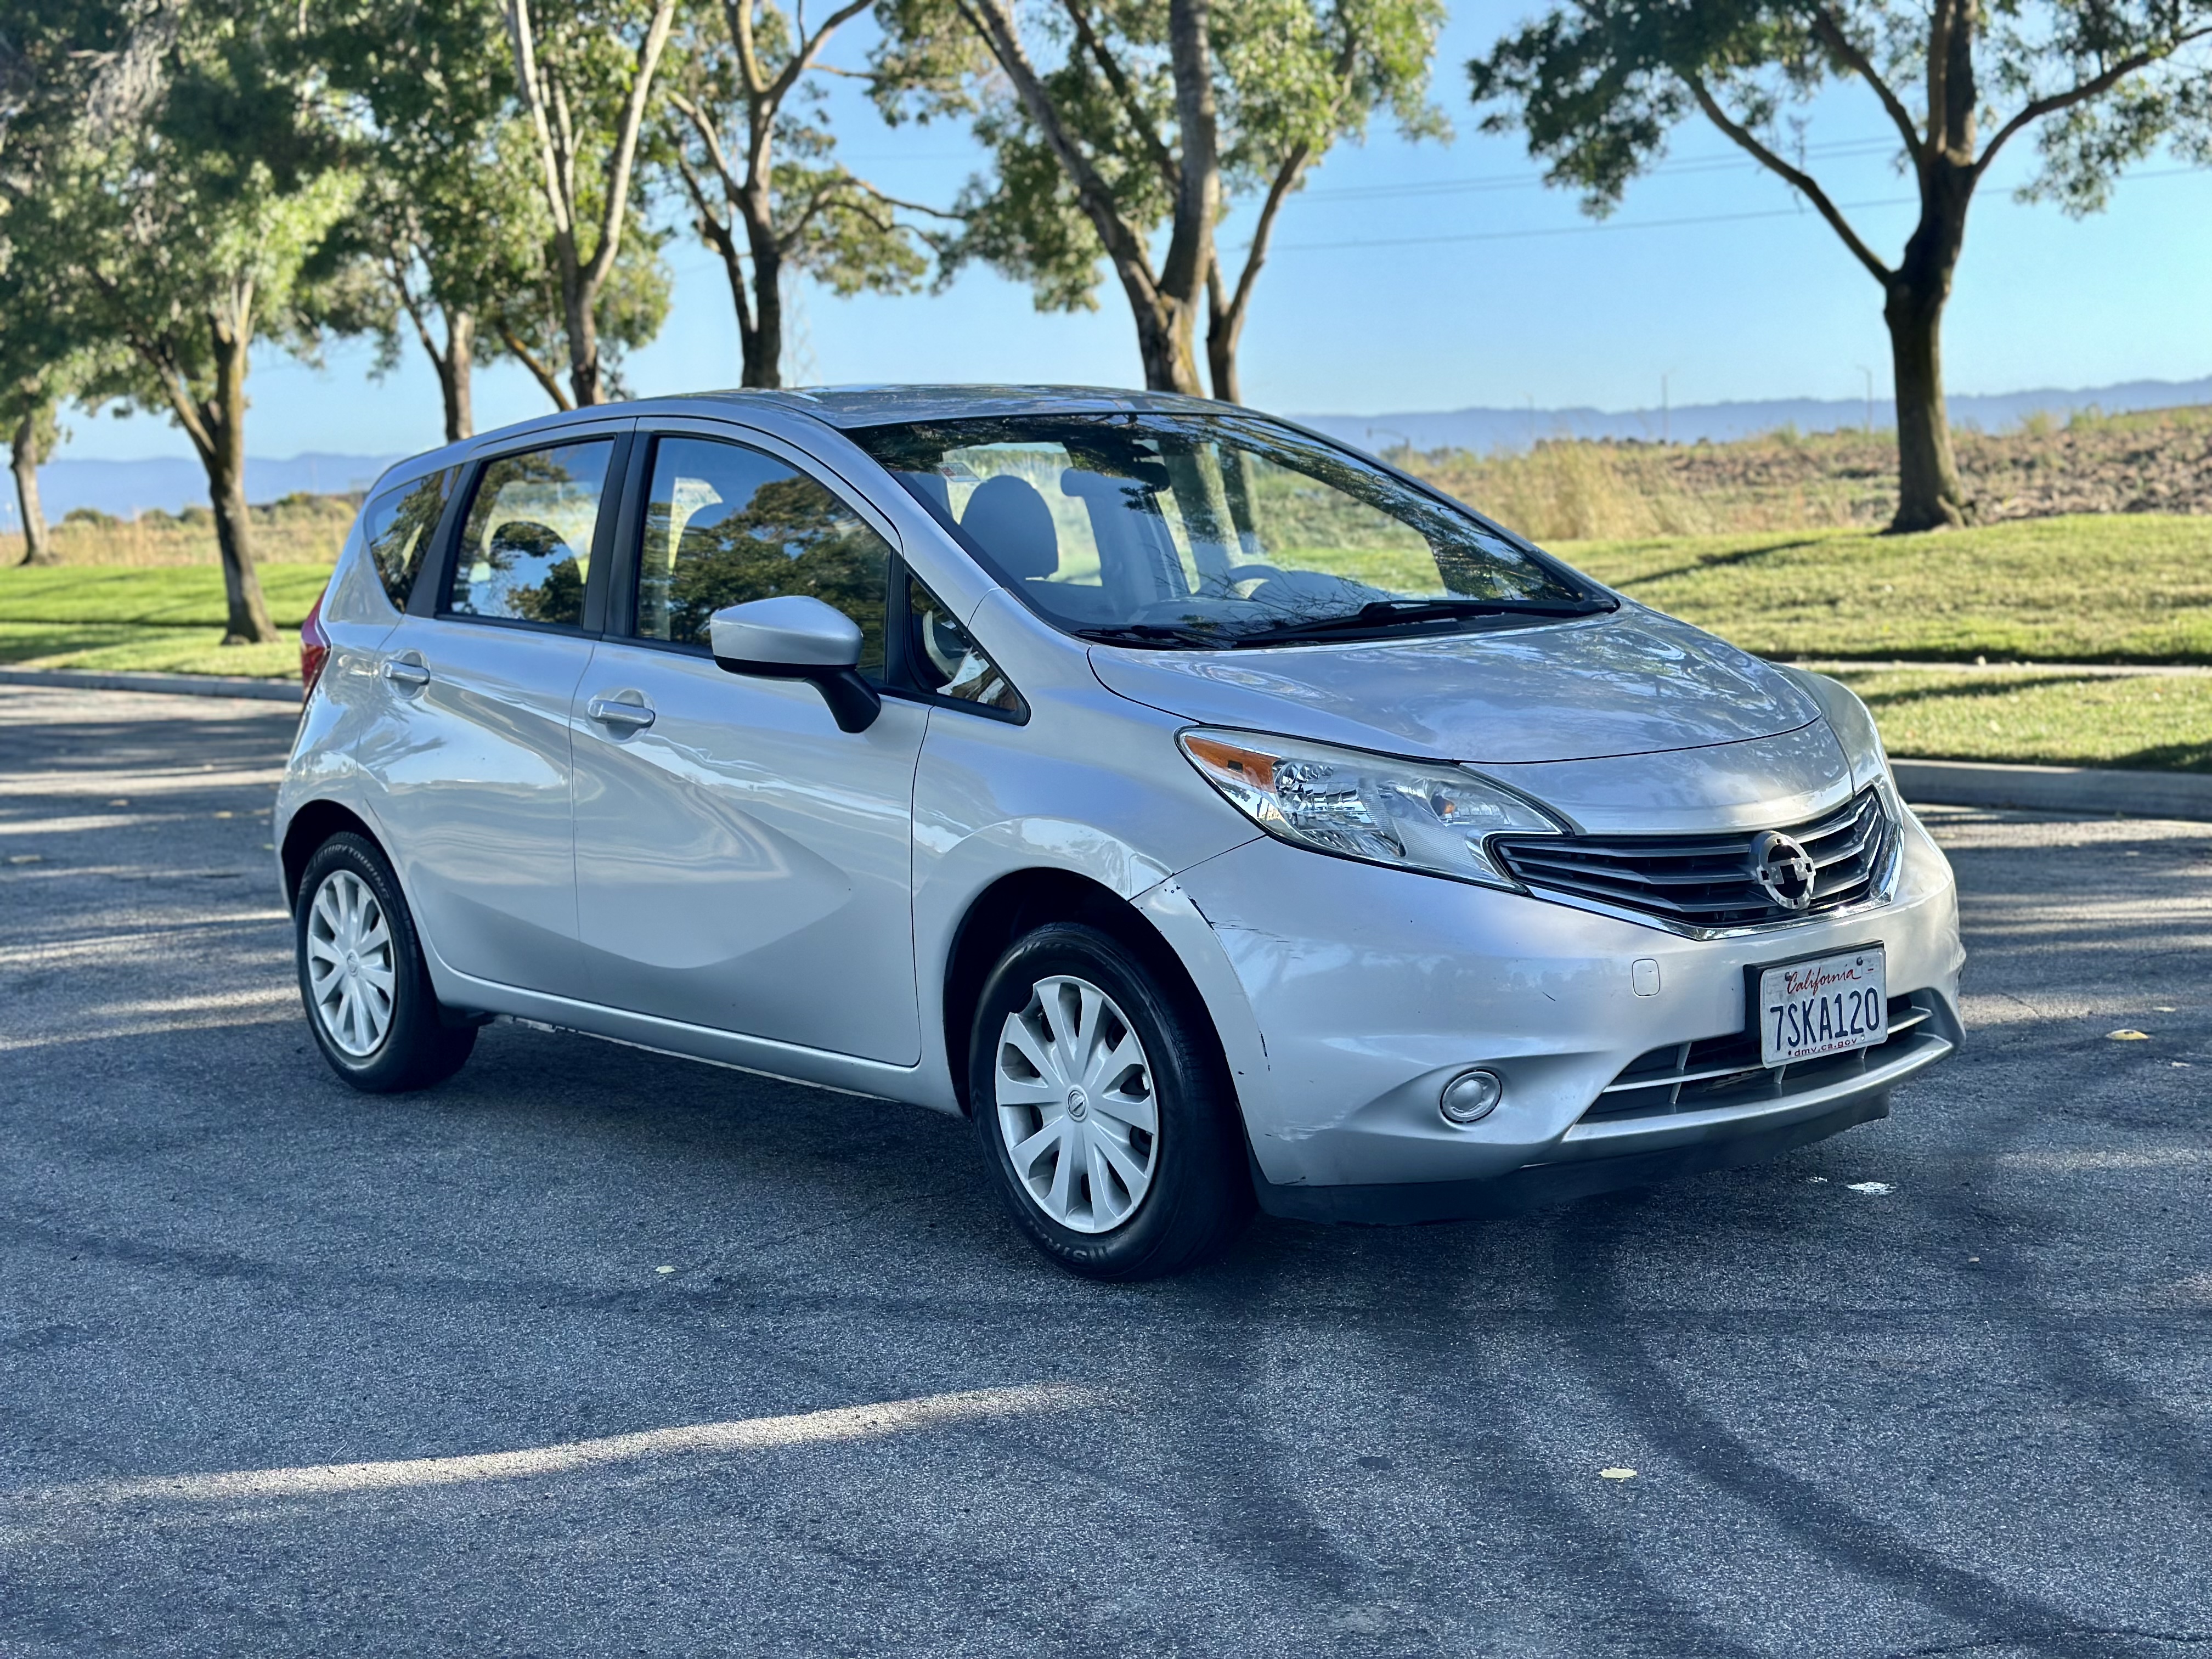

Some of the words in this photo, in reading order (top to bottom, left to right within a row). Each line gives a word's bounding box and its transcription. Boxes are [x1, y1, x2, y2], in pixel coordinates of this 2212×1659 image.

[1787, 964, 1861, 996] California
[1770, 987, 1880, 1051] 7SKA120
[1794, 1037, 1858, 1057] dmv.ca.gov
